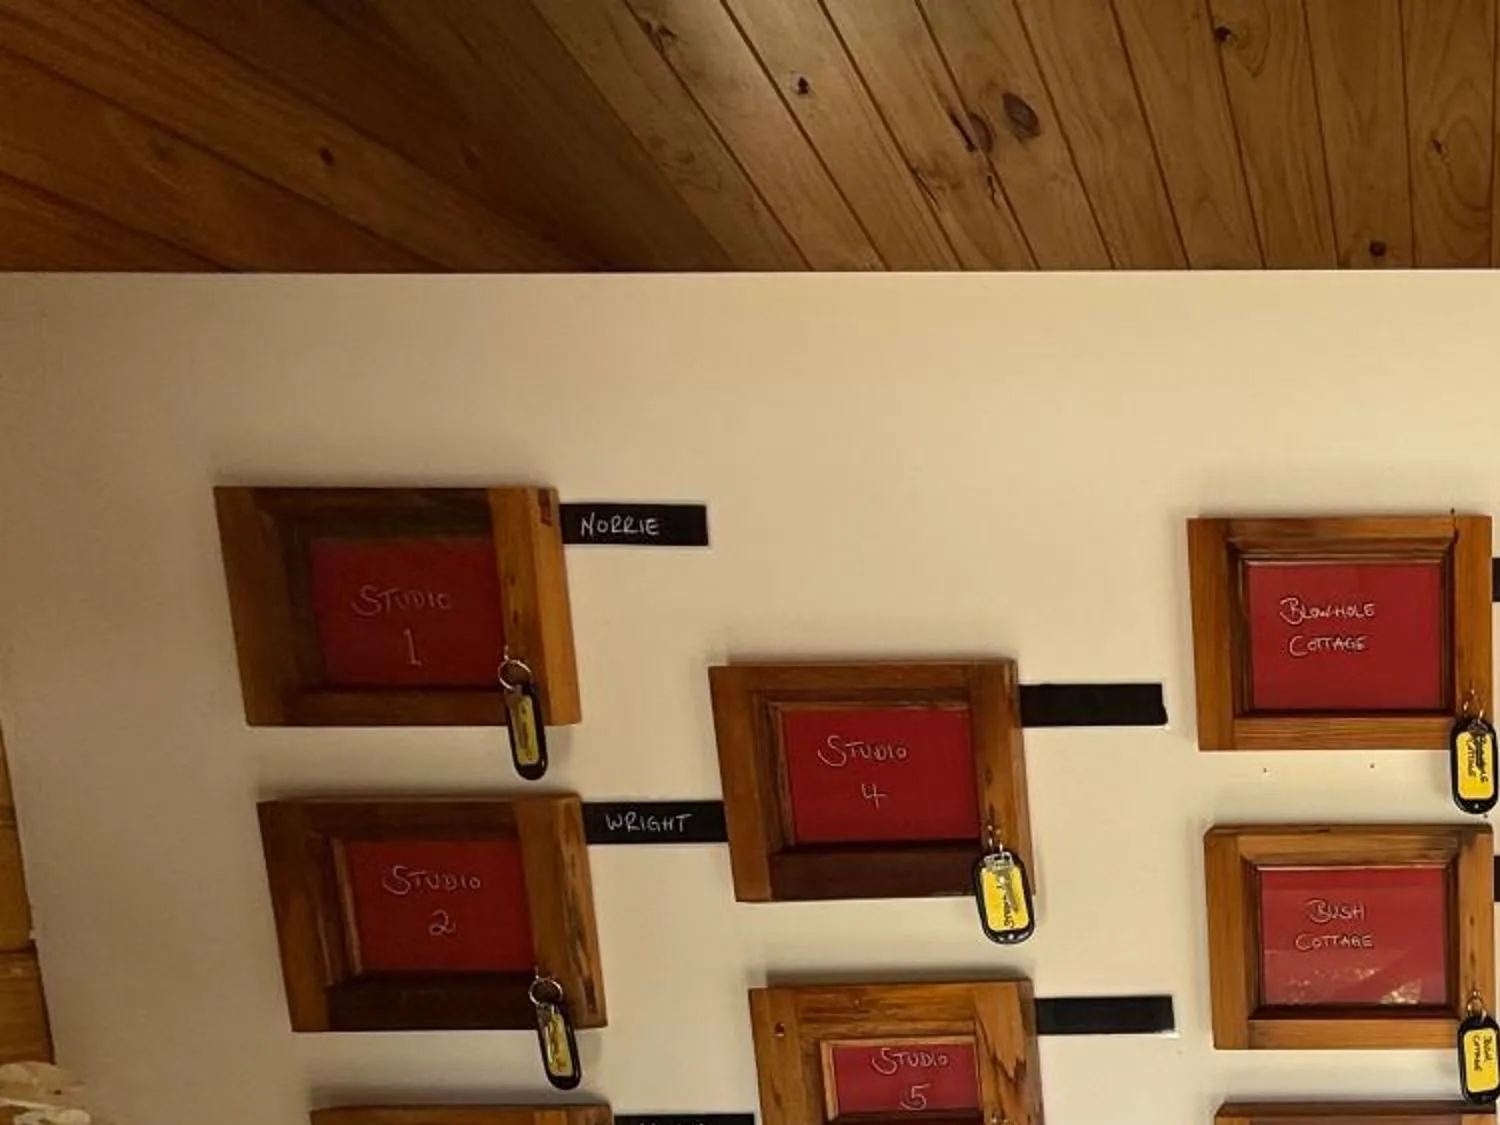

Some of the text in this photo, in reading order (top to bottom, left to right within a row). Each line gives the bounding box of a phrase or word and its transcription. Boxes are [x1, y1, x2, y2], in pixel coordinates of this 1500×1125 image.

[581, 516, 660, 537] NORRIE
[1288, 635, 1369, 657] COTTAGE
[818, 736, 907, 767] STUDIO
[861, 783, 886, 808] 4
[606, 812, 692, 834] WRIGHT
[383, 865, 481, 895] STUDIO
[428, 911, 456, 937] 2
[1305, 898, 1366, 924] BUSH
[1295, 933, 1374, 951] COTTAGE
[872, 1047, 949, 1075] STUDIO
[900, 1083, 930, 1111] 5
